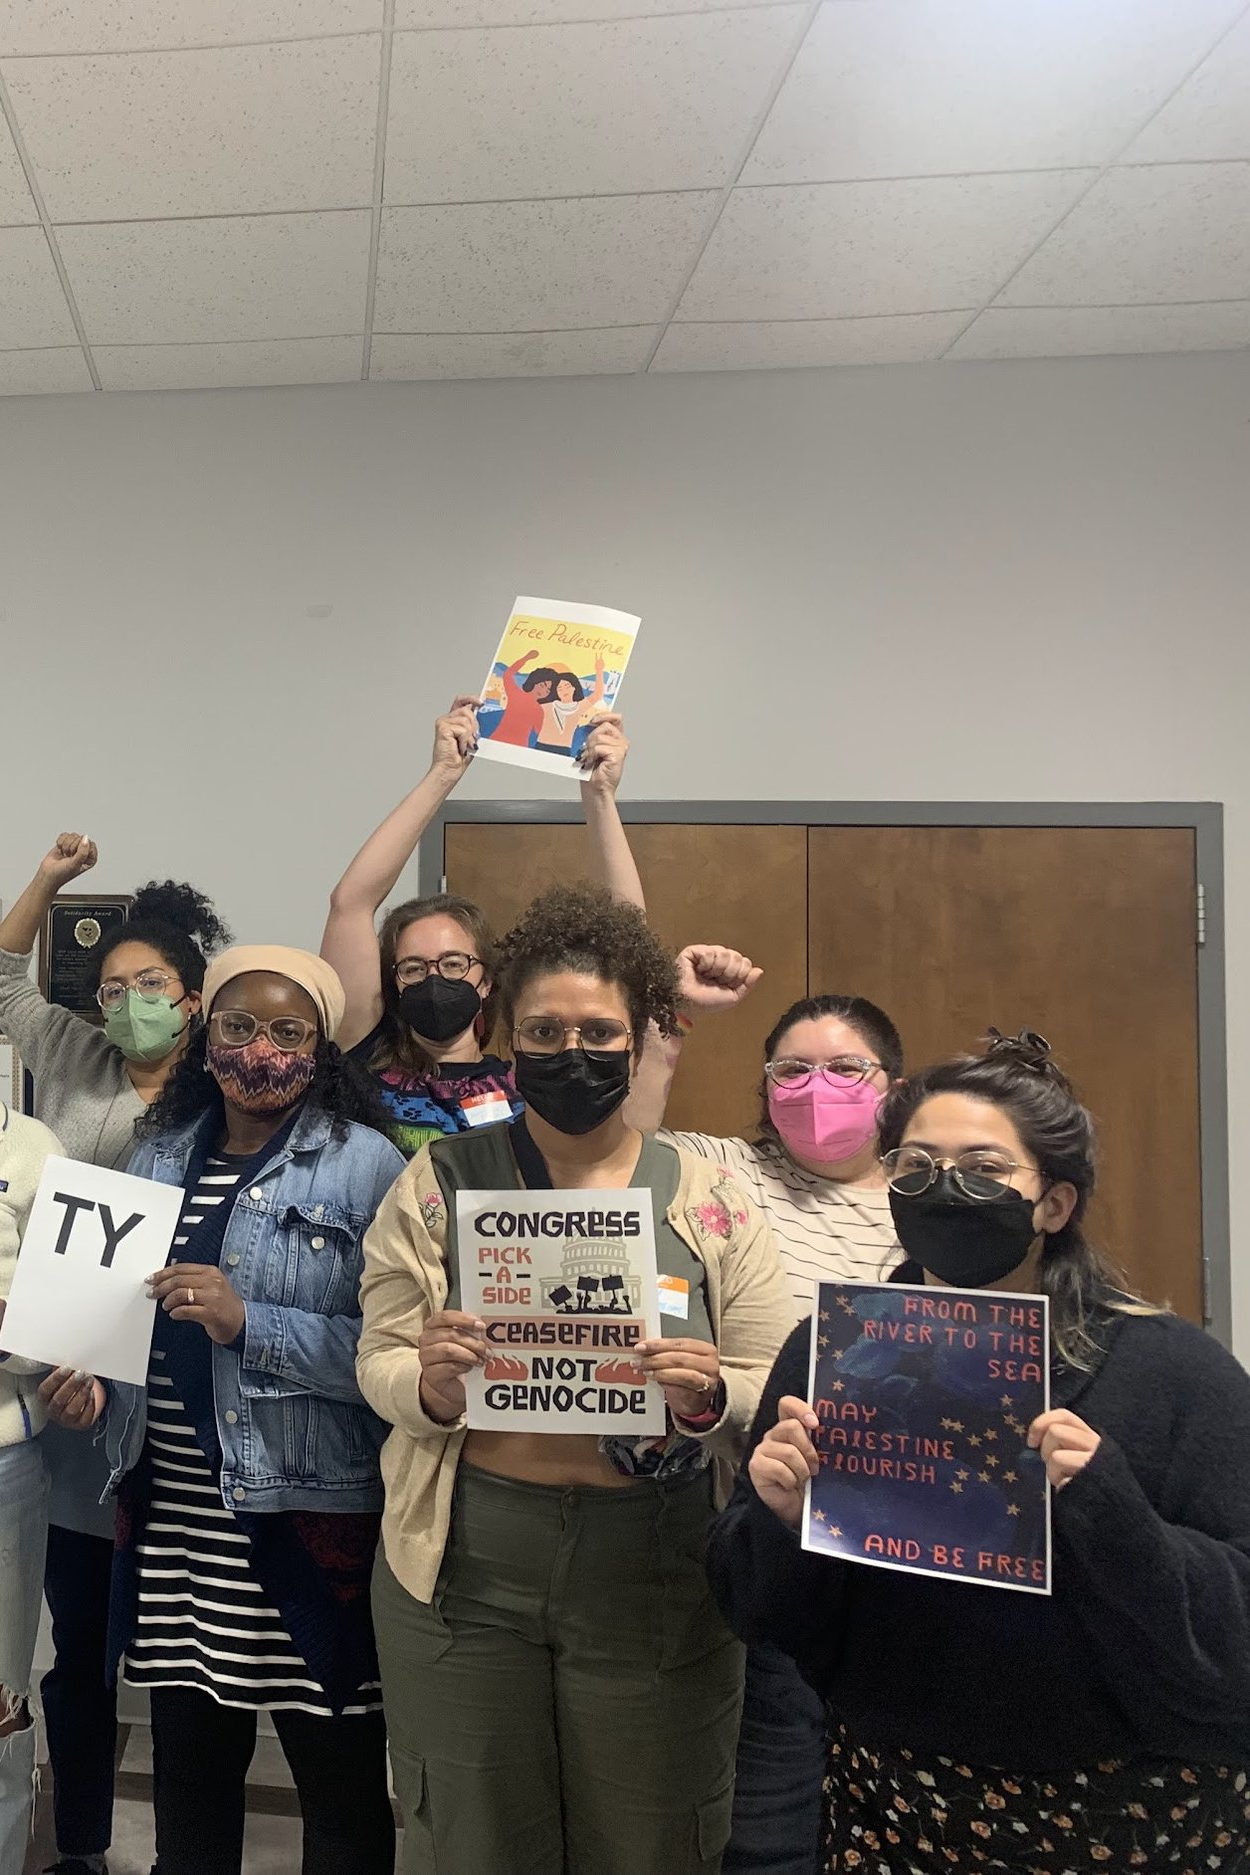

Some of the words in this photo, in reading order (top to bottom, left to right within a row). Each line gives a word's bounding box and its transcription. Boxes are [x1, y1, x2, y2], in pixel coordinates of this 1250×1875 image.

[510, 620, 544, 640] Free
[548, 623, 624, 656] Palestine
[52, 1191, 146, 1269] TY
[474, 1211, 641, 1238] CONGRESS
[478, 1246, 533, 1265] PICK
[482, 1286, 531, 1305] SIDE
[904, 1297, 977, 1323] FROM
[989, 1304, 1041, 1329] THE
[485, 1321, 640, 1348] CEASEFIRE
[863, 1319, 934, 1344] RIVER
[944, 1327, 977, 1349] TO
[989, 1331, 1041, 1356] THE
[531, 1356, 598, 1382] NOT
[987, 1359, 1041, 1383] SEA
[484, 1384, 647, 1414] GENOCIDE
[815, 1398, 878, 1424] MAY
[864, 1534, 921, 1561] AND
[933, 1544, 965, 1569] BE
[978, 1551, 1045, 1582] FREE
